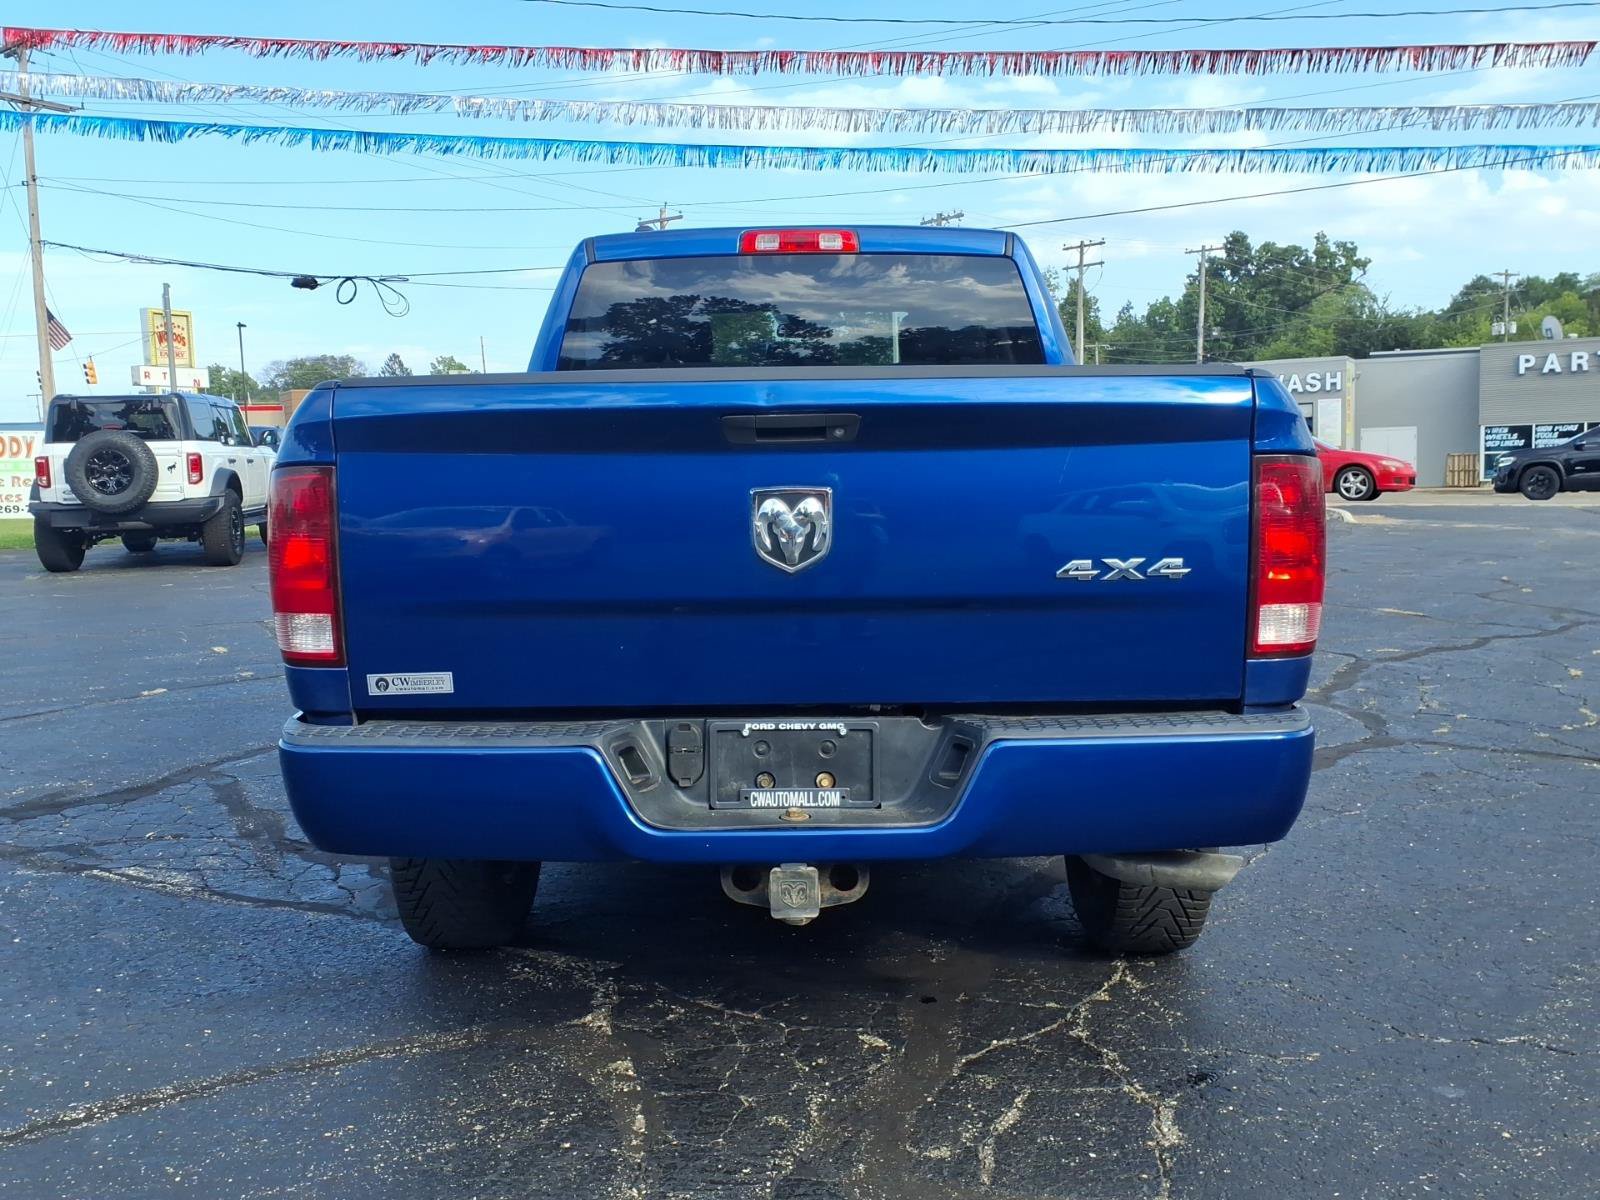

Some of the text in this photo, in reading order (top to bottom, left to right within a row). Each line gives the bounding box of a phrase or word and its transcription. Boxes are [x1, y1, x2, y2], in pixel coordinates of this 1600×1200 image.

[1519, 351, 1600, 374] PAR
[1280, 371, 1342, 393] ASH
[750, 791, 840, 807] CWAUTOMALL.COM
